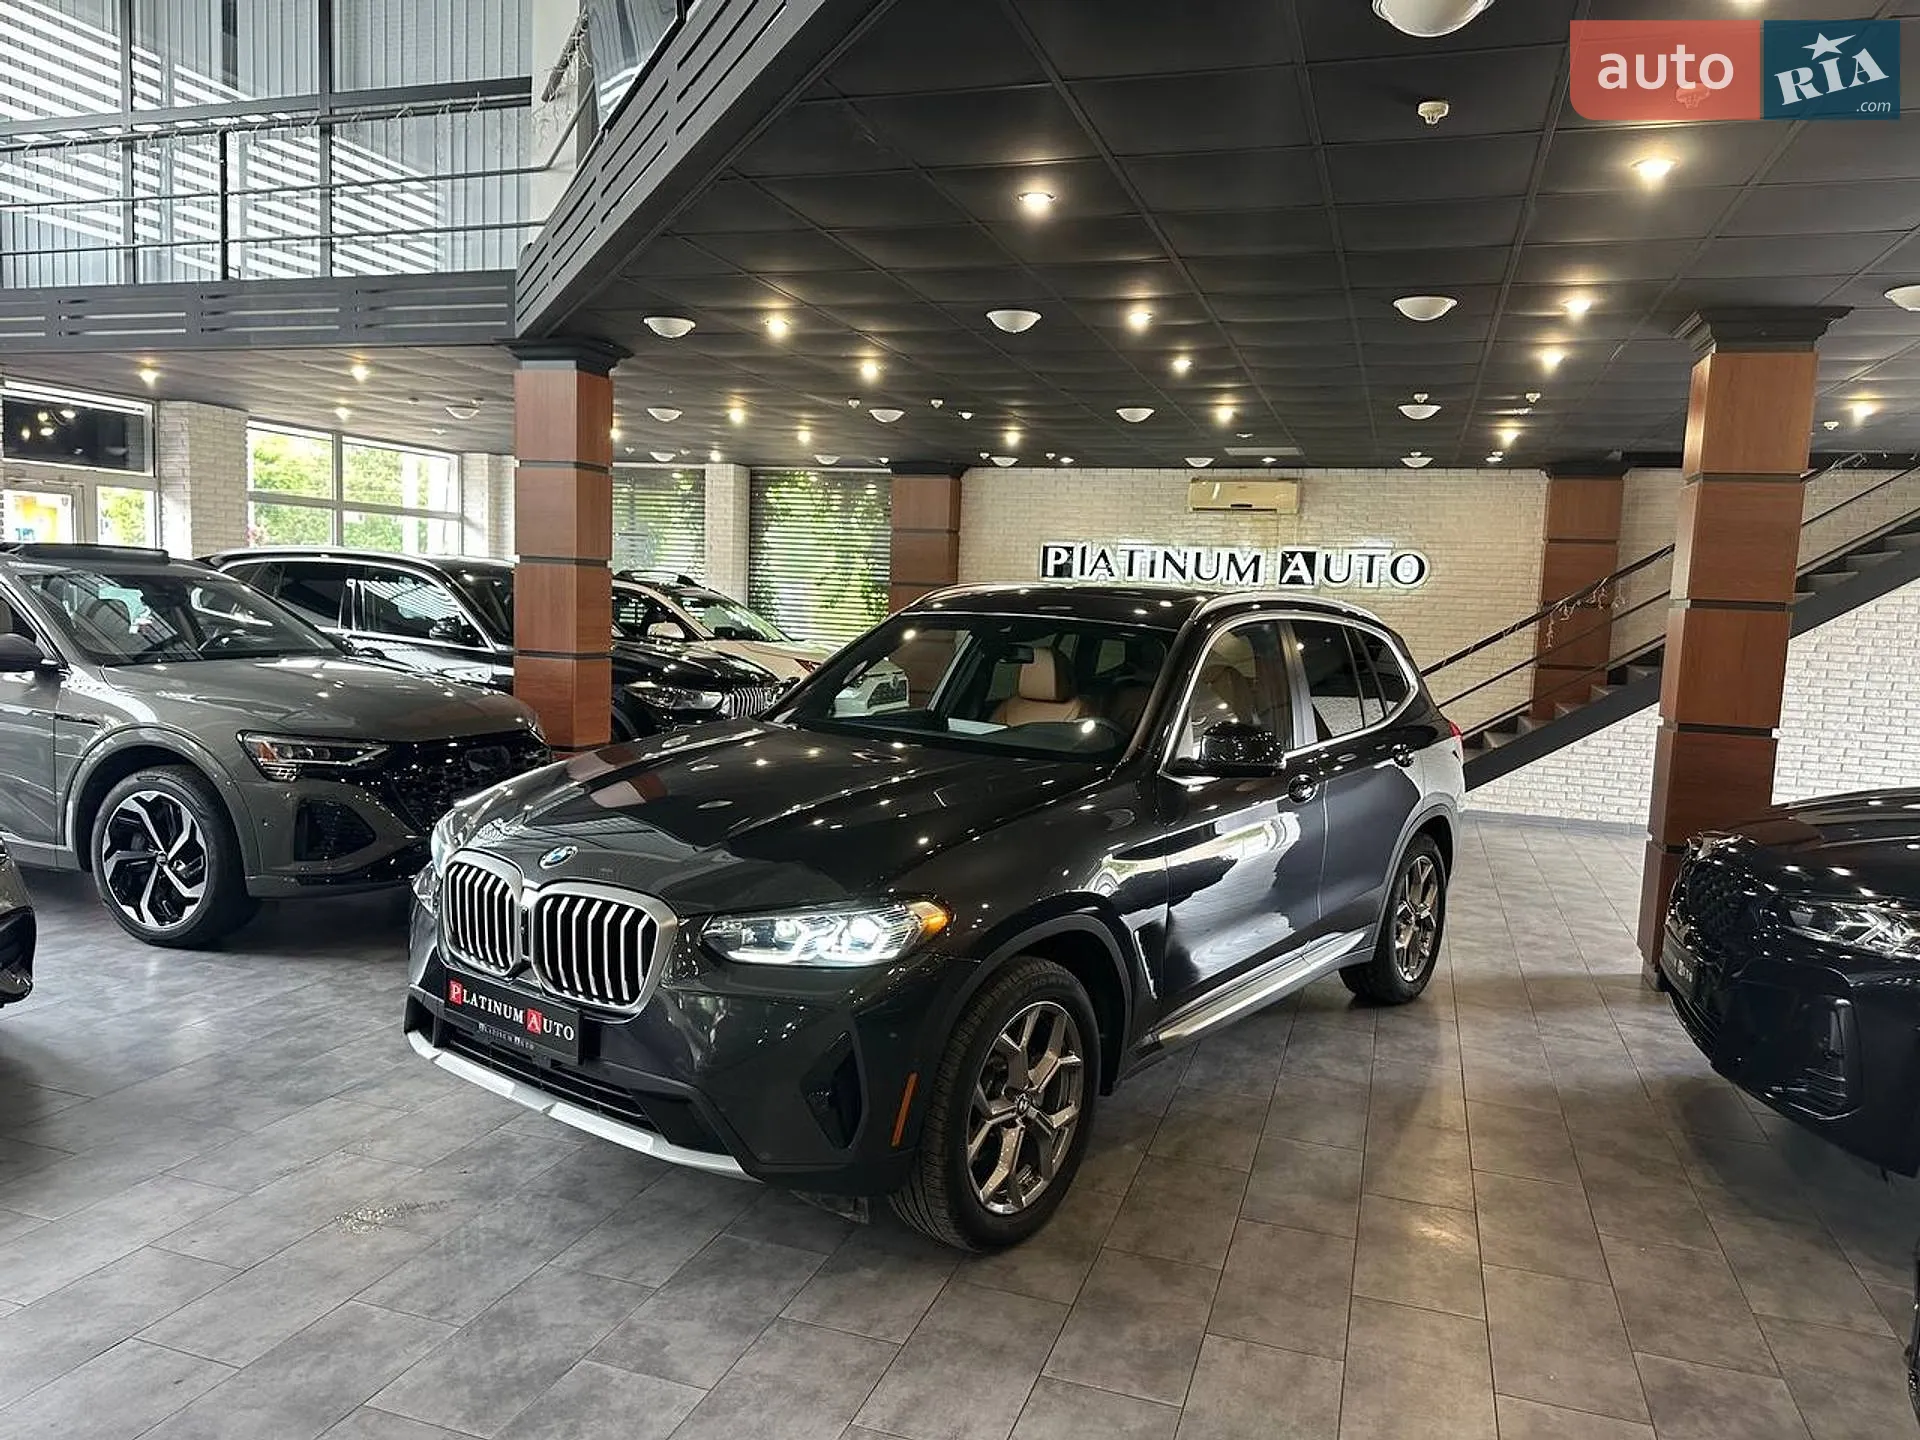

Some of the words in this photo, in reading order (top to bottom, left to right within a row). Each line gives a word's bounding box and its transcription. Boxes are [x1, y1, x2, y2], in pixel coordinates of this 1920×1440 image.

[1279, 550, 1426, 586] AUTO
[449, 978, 525, 1025] PLATINUM
[526, 1008, 575, 1041] AUTO
